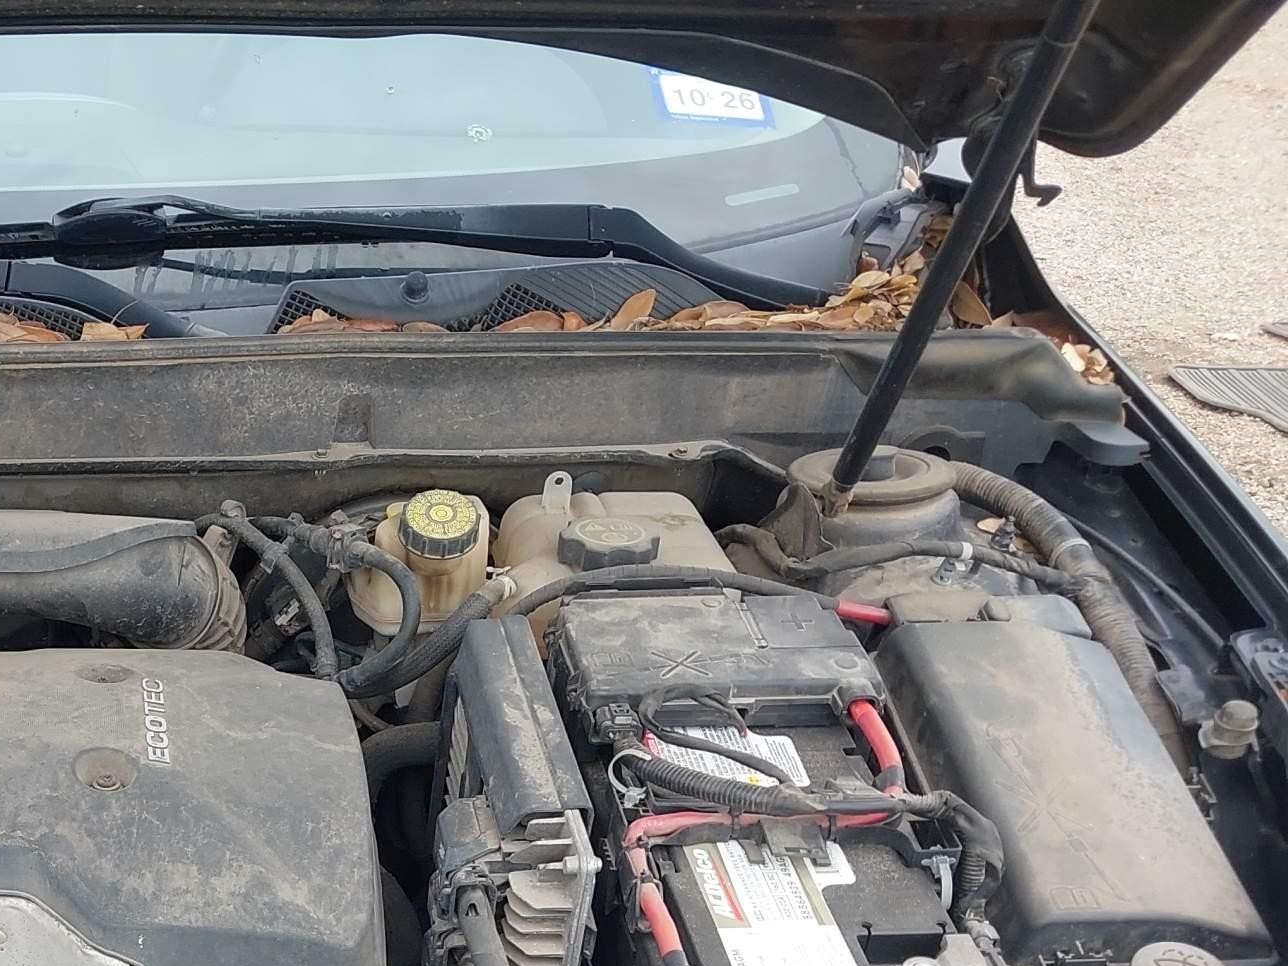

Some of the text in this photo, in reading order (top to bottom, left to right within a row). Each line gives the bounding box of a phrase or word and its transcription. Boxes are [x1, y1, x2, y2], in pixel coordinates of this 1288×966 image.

[673, 88, 755, 110] 10 26
[142, 677, 171, 765] ECOTEC
[692, 846, 736, 919] ACDelco
[775, 855, 792, 877] 49AG
